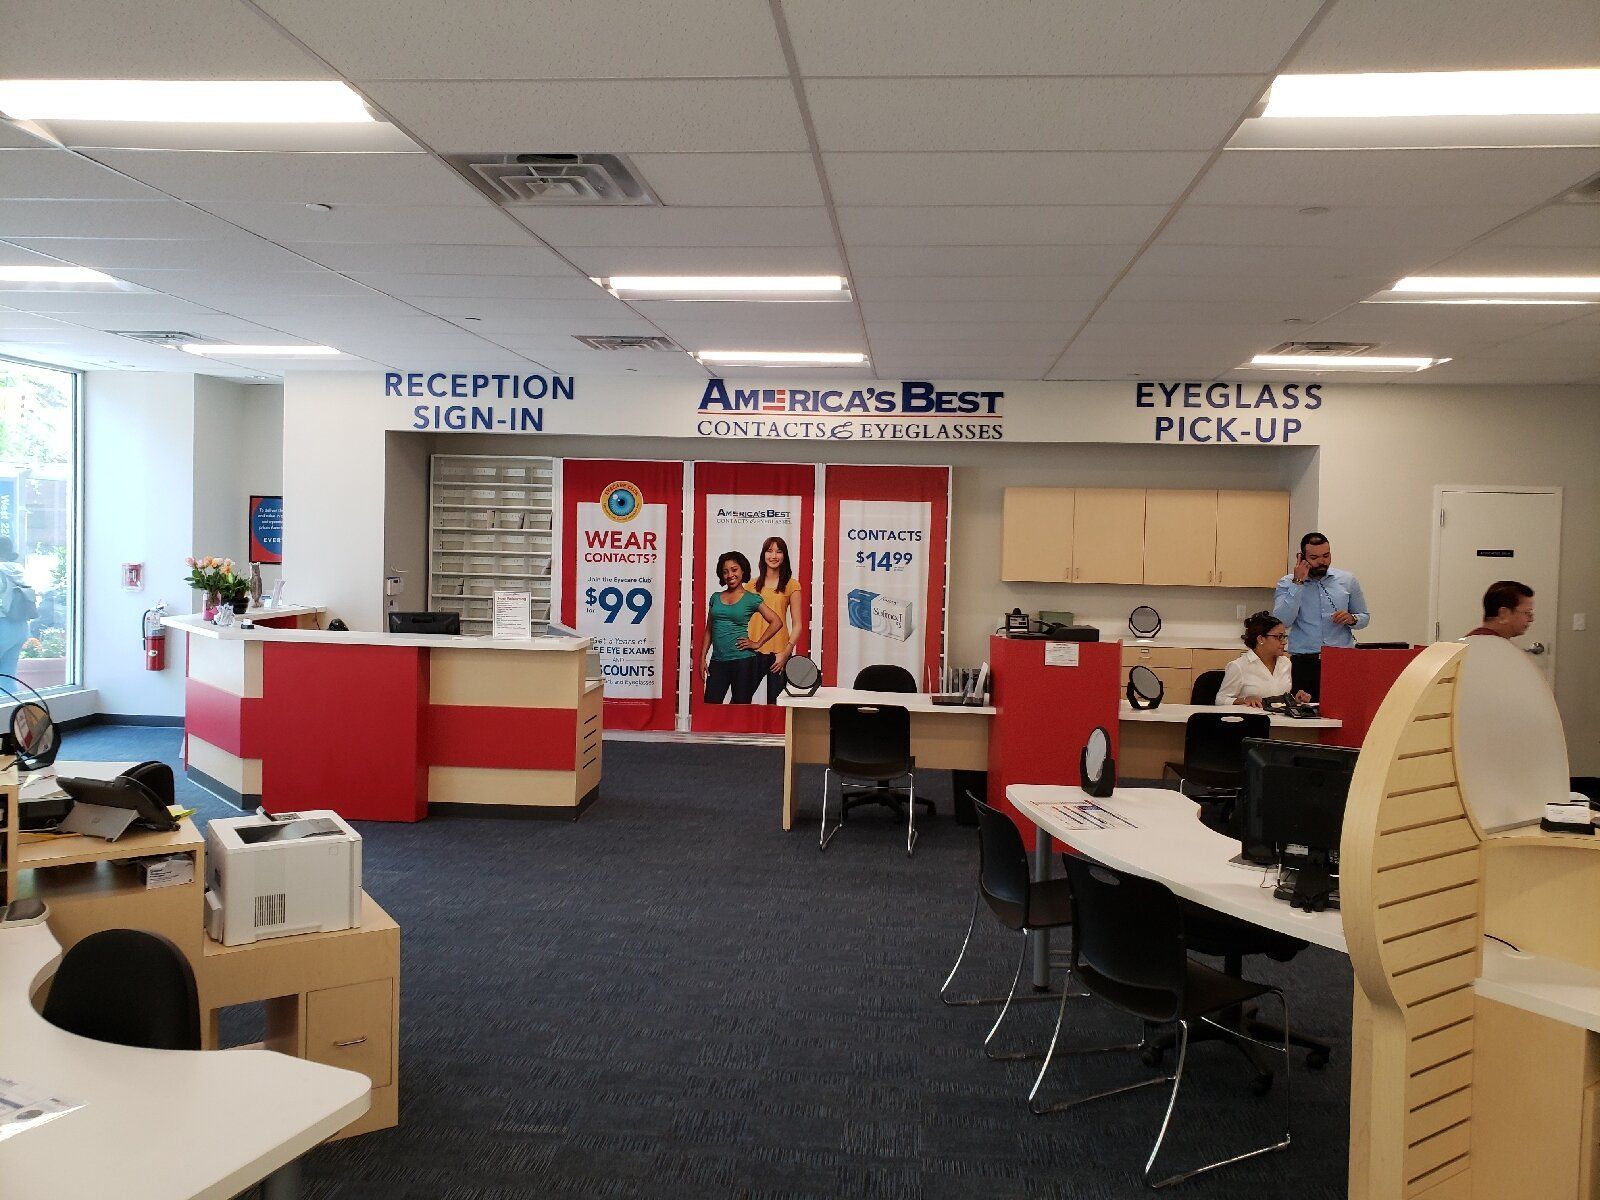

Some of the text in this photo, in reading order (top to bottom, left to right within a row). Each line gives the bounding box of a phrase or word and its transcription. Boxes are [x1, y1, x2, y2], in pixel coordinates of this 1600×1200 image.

[385, 372, 574, 400] RECEPTION
[697, 378, 1004, 414] AMERICA'S BEST
[1136, 382, 1322, 410] EYEGLASS
[413, 405, 543, 432] SIGN-IN
[697, 420, 1004, 440] CONTACTS & EYEGLASSES
[1155, 416, 1302, 443] PICK-UP
[767, 509, 790, 518] BEST
[584, 530, 657, 550] WEAR
[848, 529, 922, 542] CONTACTS
[584, 552, 657, 564] CONTACTS?
[585, 586, 652, 624] $99
[606, 646, 620, 654] EYE
[600, 664, 654, 676] COUNTS
